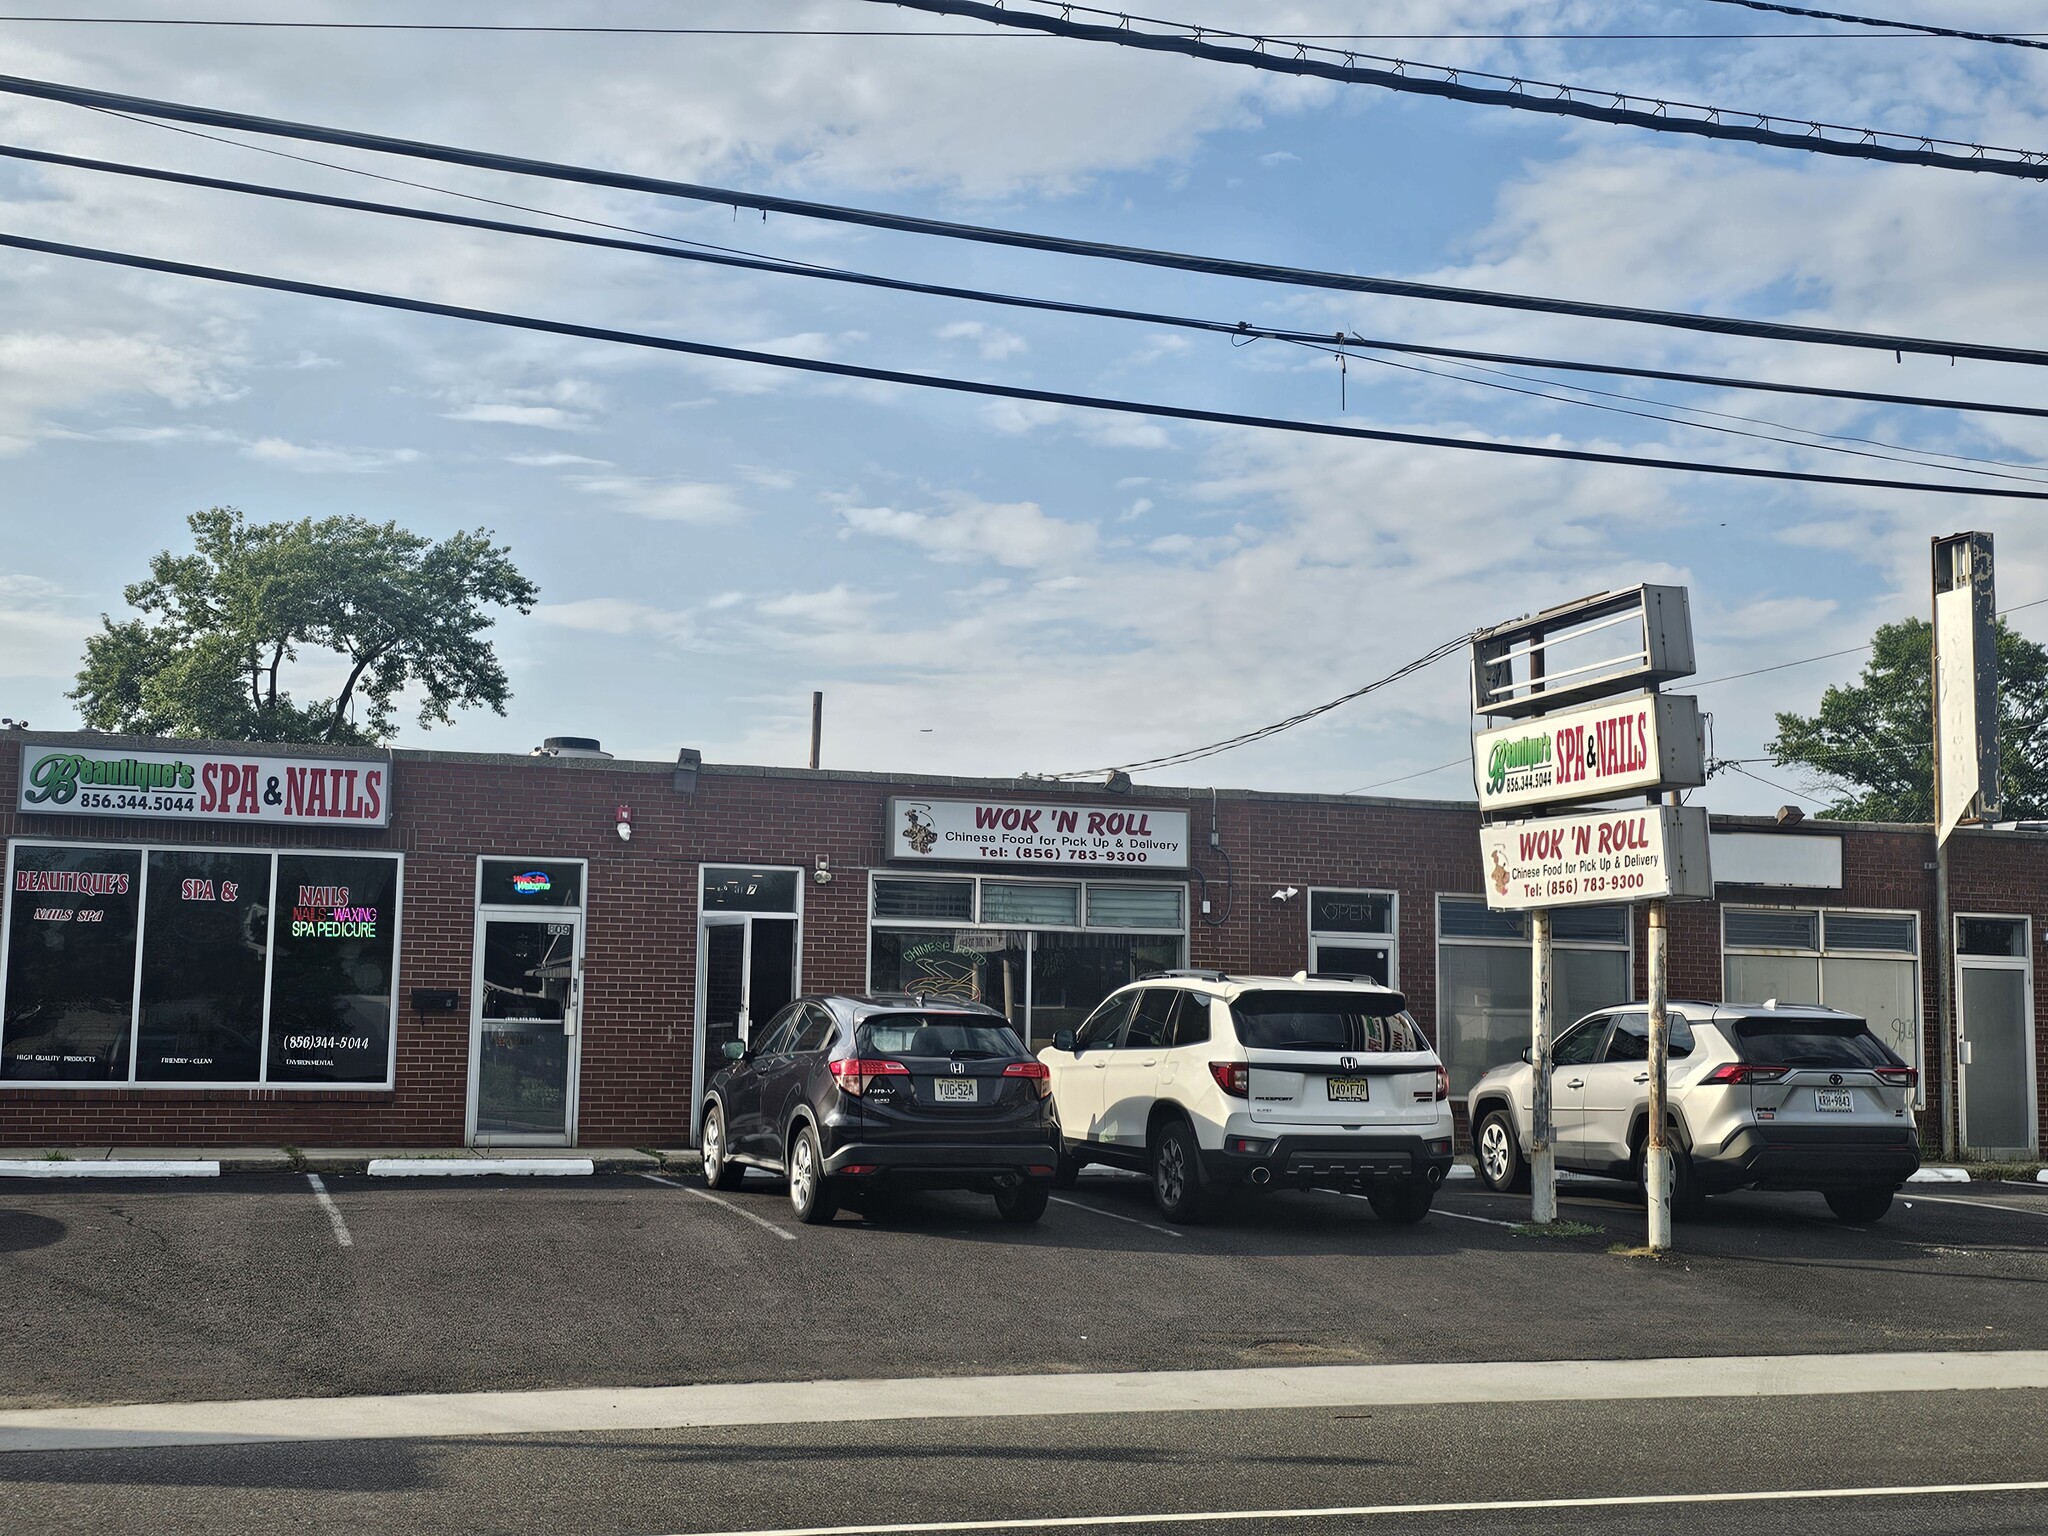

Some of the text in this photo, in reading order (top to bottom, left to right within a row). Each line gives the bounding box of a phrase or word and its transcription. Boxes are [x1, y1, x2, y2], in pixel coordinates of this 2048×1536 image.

[1556, 725, 1586, 785] SPA
[1586, 735, 1596, 768] &
[1596, 712, 1647, 778] NAILS
[24, 753, 382, 820] Beautique's SPA & NAILS
[1506, 771, 1552, 793] 856.344.5044
[80, 793, 195, 812] 856.344.5044
[974, 806, 1153, 837] WOK 'N ROLL
[945, 831, 1179, 852] Chinese Food for Pick Up & Delivery
[1519, 817, 1649, 861] WOK 'N ROLL
[979, 846, 1148, 863] Tel: (856) 783-9300
[1512, 854, 1659, 880] Chinese Food for Pick Up & Delivery
[15, 870, 349, 907] BEAUTIQUE'S SPA & NAILS
[1524, 873, 1644, 897] Tel: (856) 783-9300
[33, 908, 104, 922] NAILS SPA
[1322, 902, 1373, 920] OPEN
[292, 920, 376, 938] SPA PEDICURE
[549, 924, 569, 935] 809
[957, 944, 987, 965] FOOD
[286, 1058, 334, 1066] ENVIRONMENTAL
